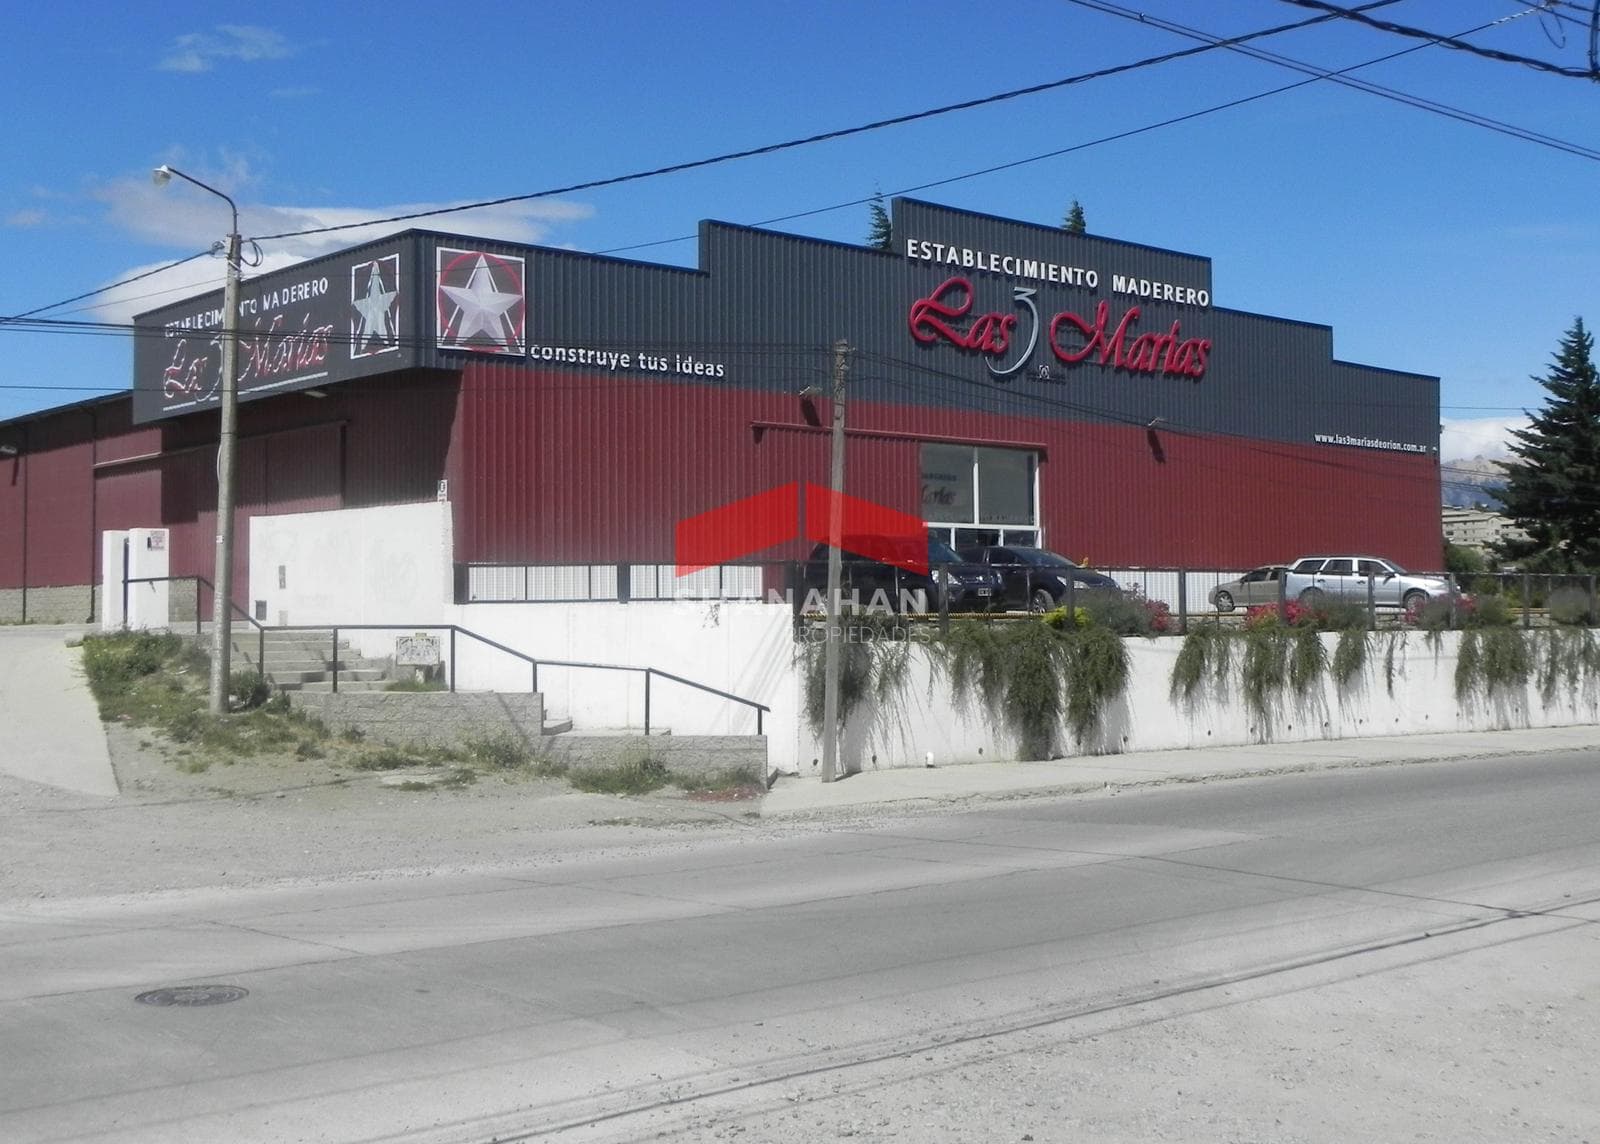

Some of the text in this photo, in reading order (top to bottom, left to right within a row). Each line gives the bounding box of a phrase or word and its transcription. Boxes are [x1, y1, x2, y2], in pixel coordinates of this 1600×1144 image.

[907, 239, 1209, 307] ESTABLECIMIENTO MADERERO
[165, 277, 329, 337] ESTABLECIMNTO MADERERO
[909, 276, 1017, 353] Las
[985, 286, 1039, 374] 3
[530, 344, 724, 377] construye tus ideas
[1314, 434, 1427, 452] www.las3mariasdeorion.com.ar
